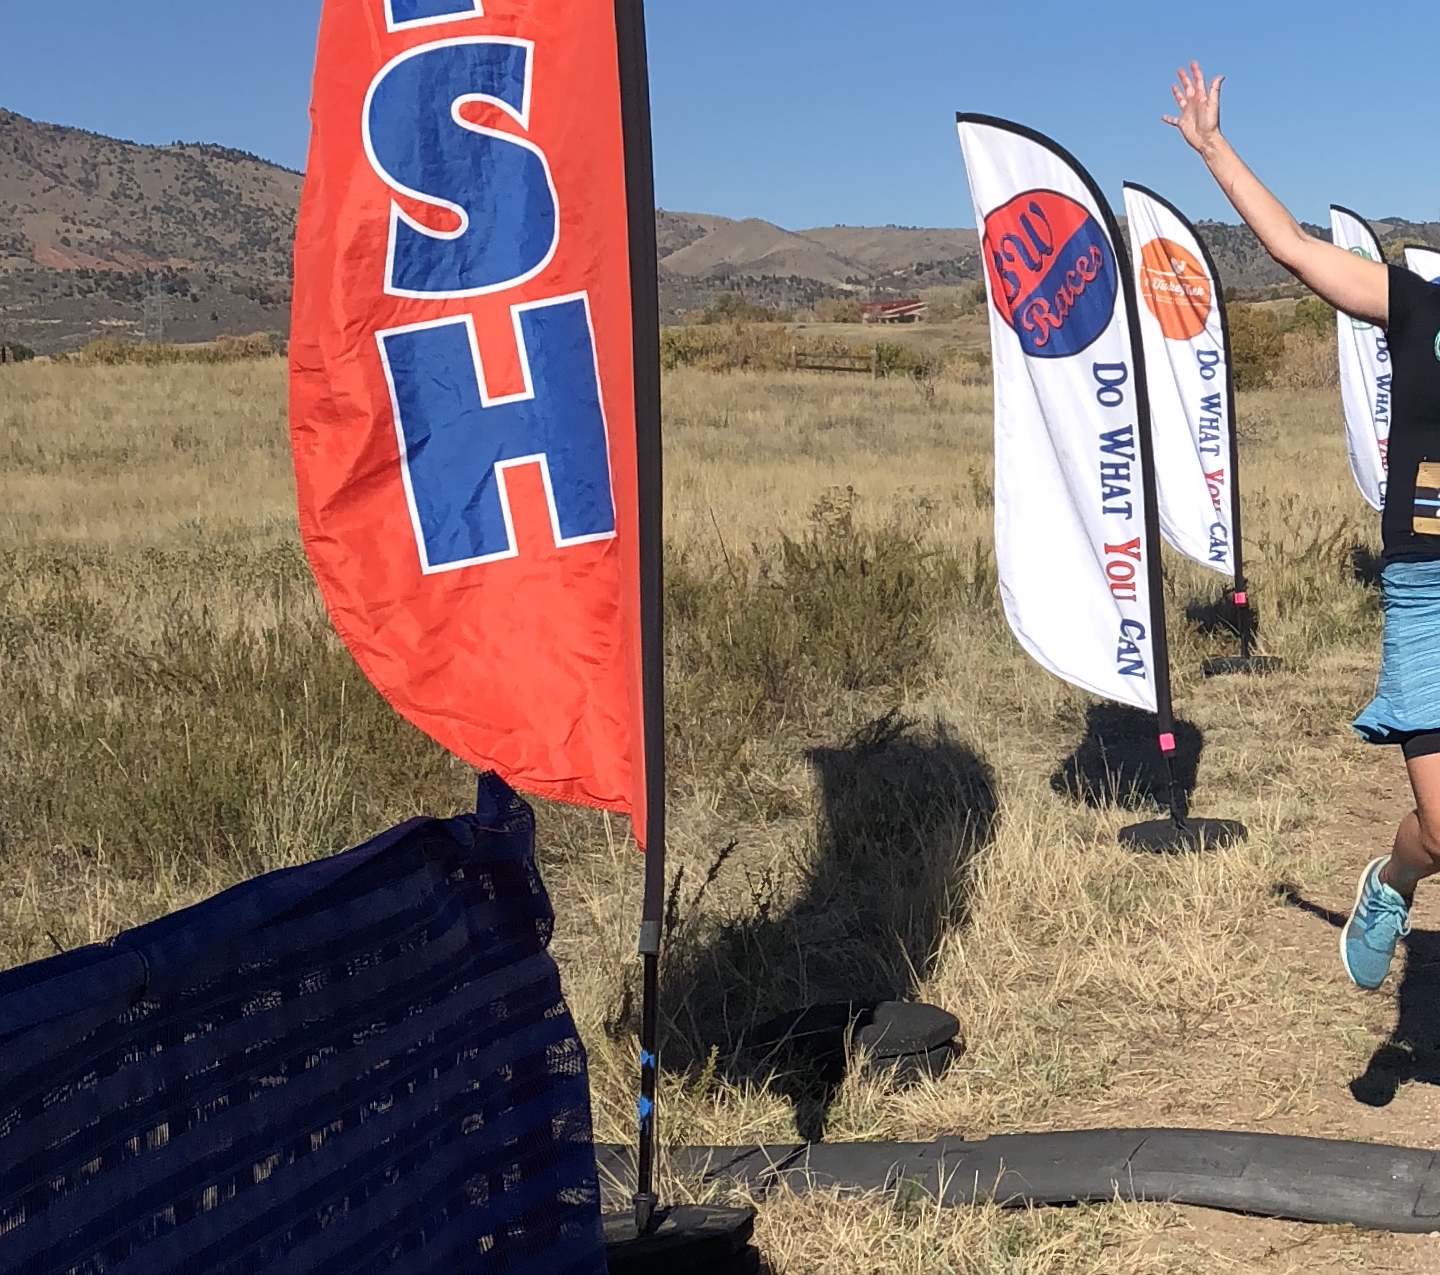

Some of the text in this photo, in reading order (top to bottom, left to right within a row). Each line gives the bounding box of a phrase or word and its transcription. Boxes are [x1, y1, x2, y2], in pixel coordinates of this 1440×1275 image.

[1022, 245, 1103, 347] Races
[1196, 349, 1220, 381] DO
[1198, 391, 1222, 457] WHAT
[1374, 372, 1392, 427] WHAT
[1092, 361, 1147, 680] DO WHAT YOU CAN
[1208, 521, 1228, 563] CAN
